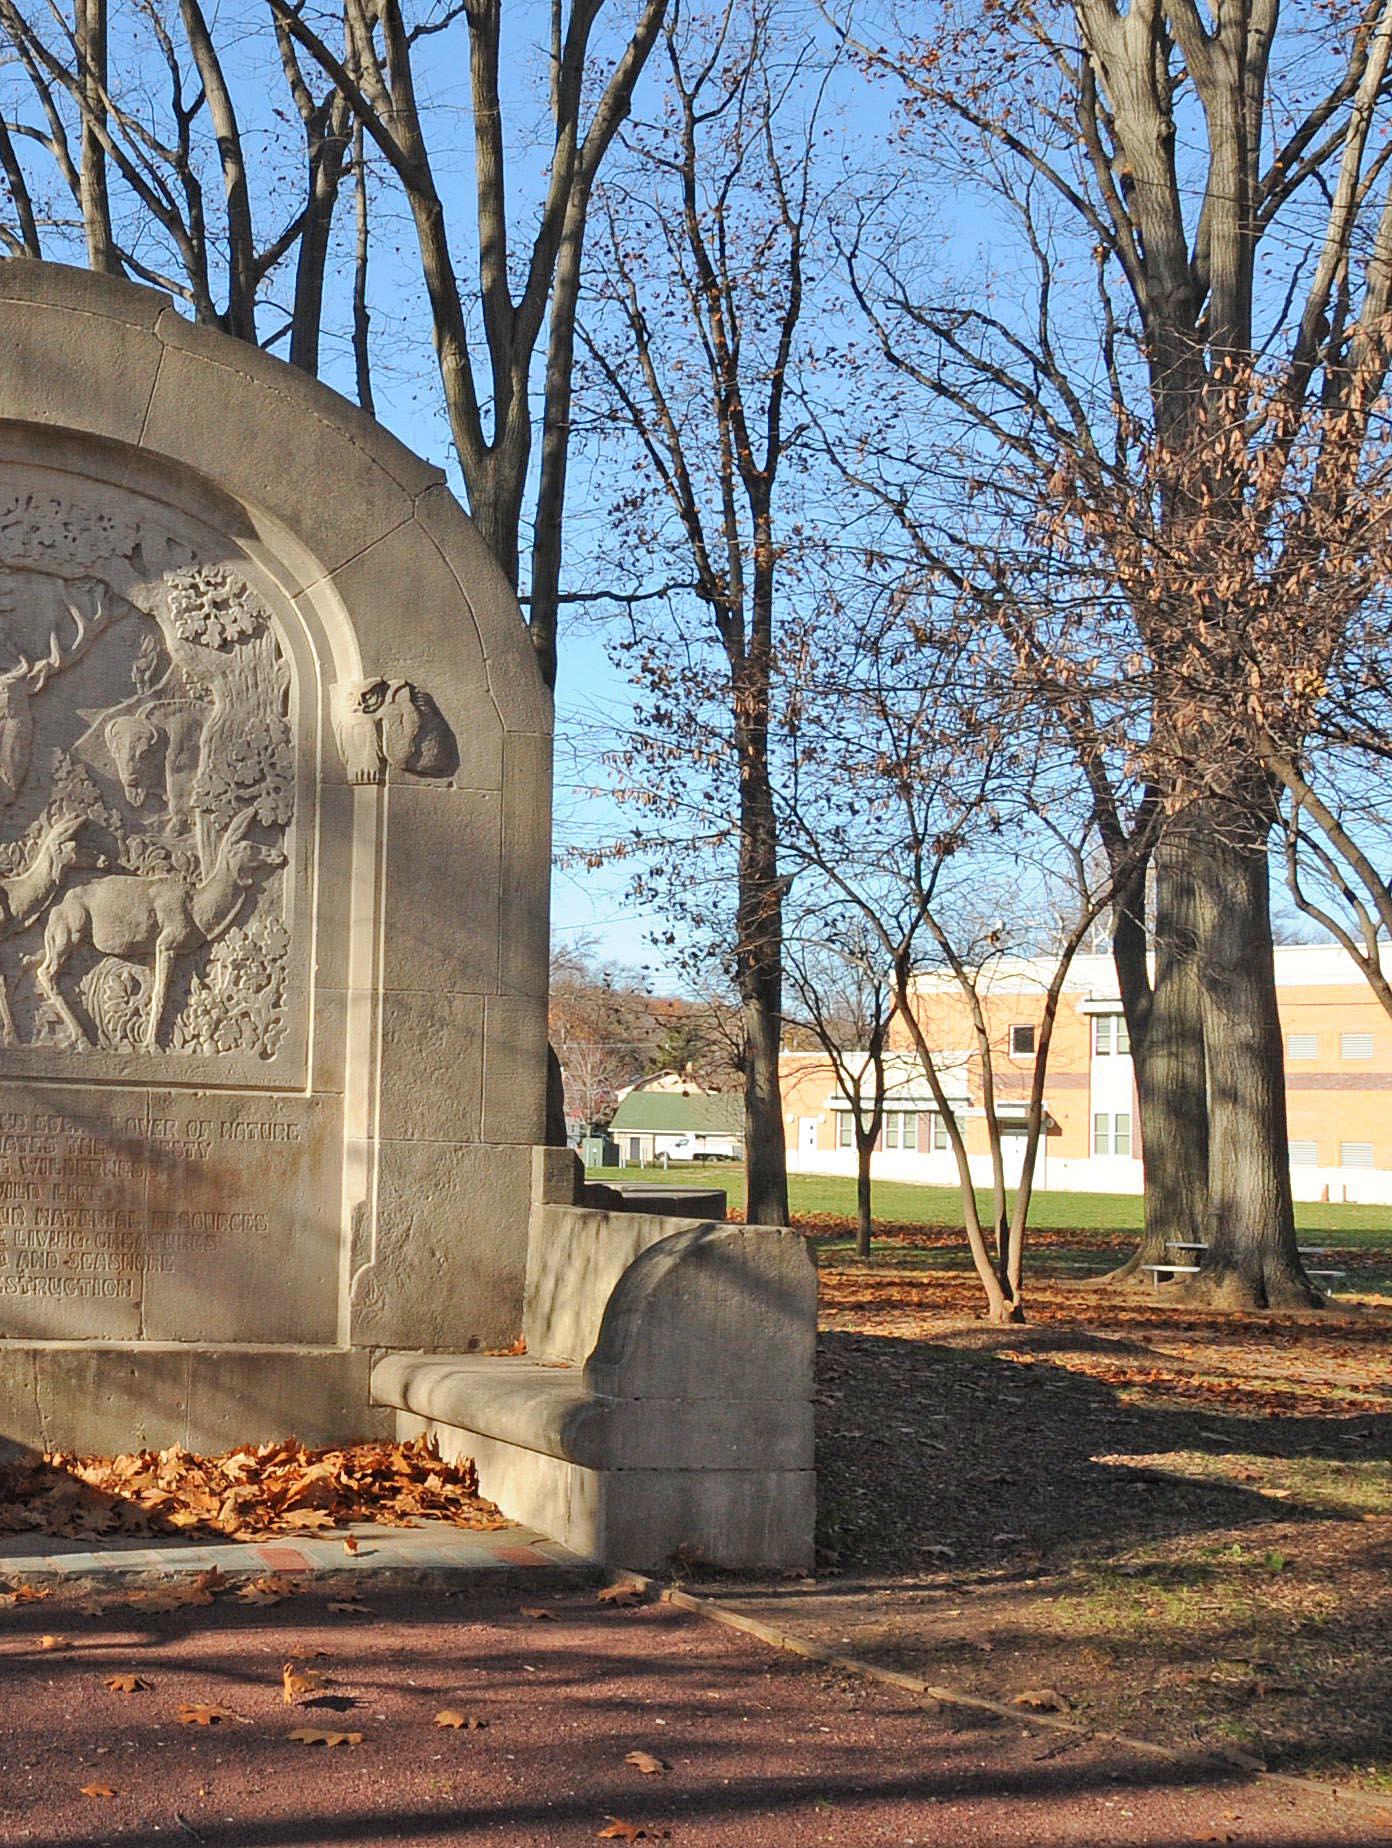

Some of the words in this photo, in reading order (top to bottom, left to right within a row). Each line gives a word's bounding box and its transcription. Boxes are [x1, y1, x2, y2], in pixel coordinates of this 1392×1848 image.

[185, 1119, 215, 1141] OF
[220, 1119, 302, 1142] NATURE
[18, 1156, 160, 1180] WILDERNESS
[34, 1207, 144, 1230] MATERIAL
[150, 1210, 270, 1233] RESOURCES
[13, 1228, 86, 1250] LIVING
[94, 1231, 219, 1252] CREATURES
[15, 1249, 59, 1271] AND
[66, 1251, 177, 1274] SEASHORE
